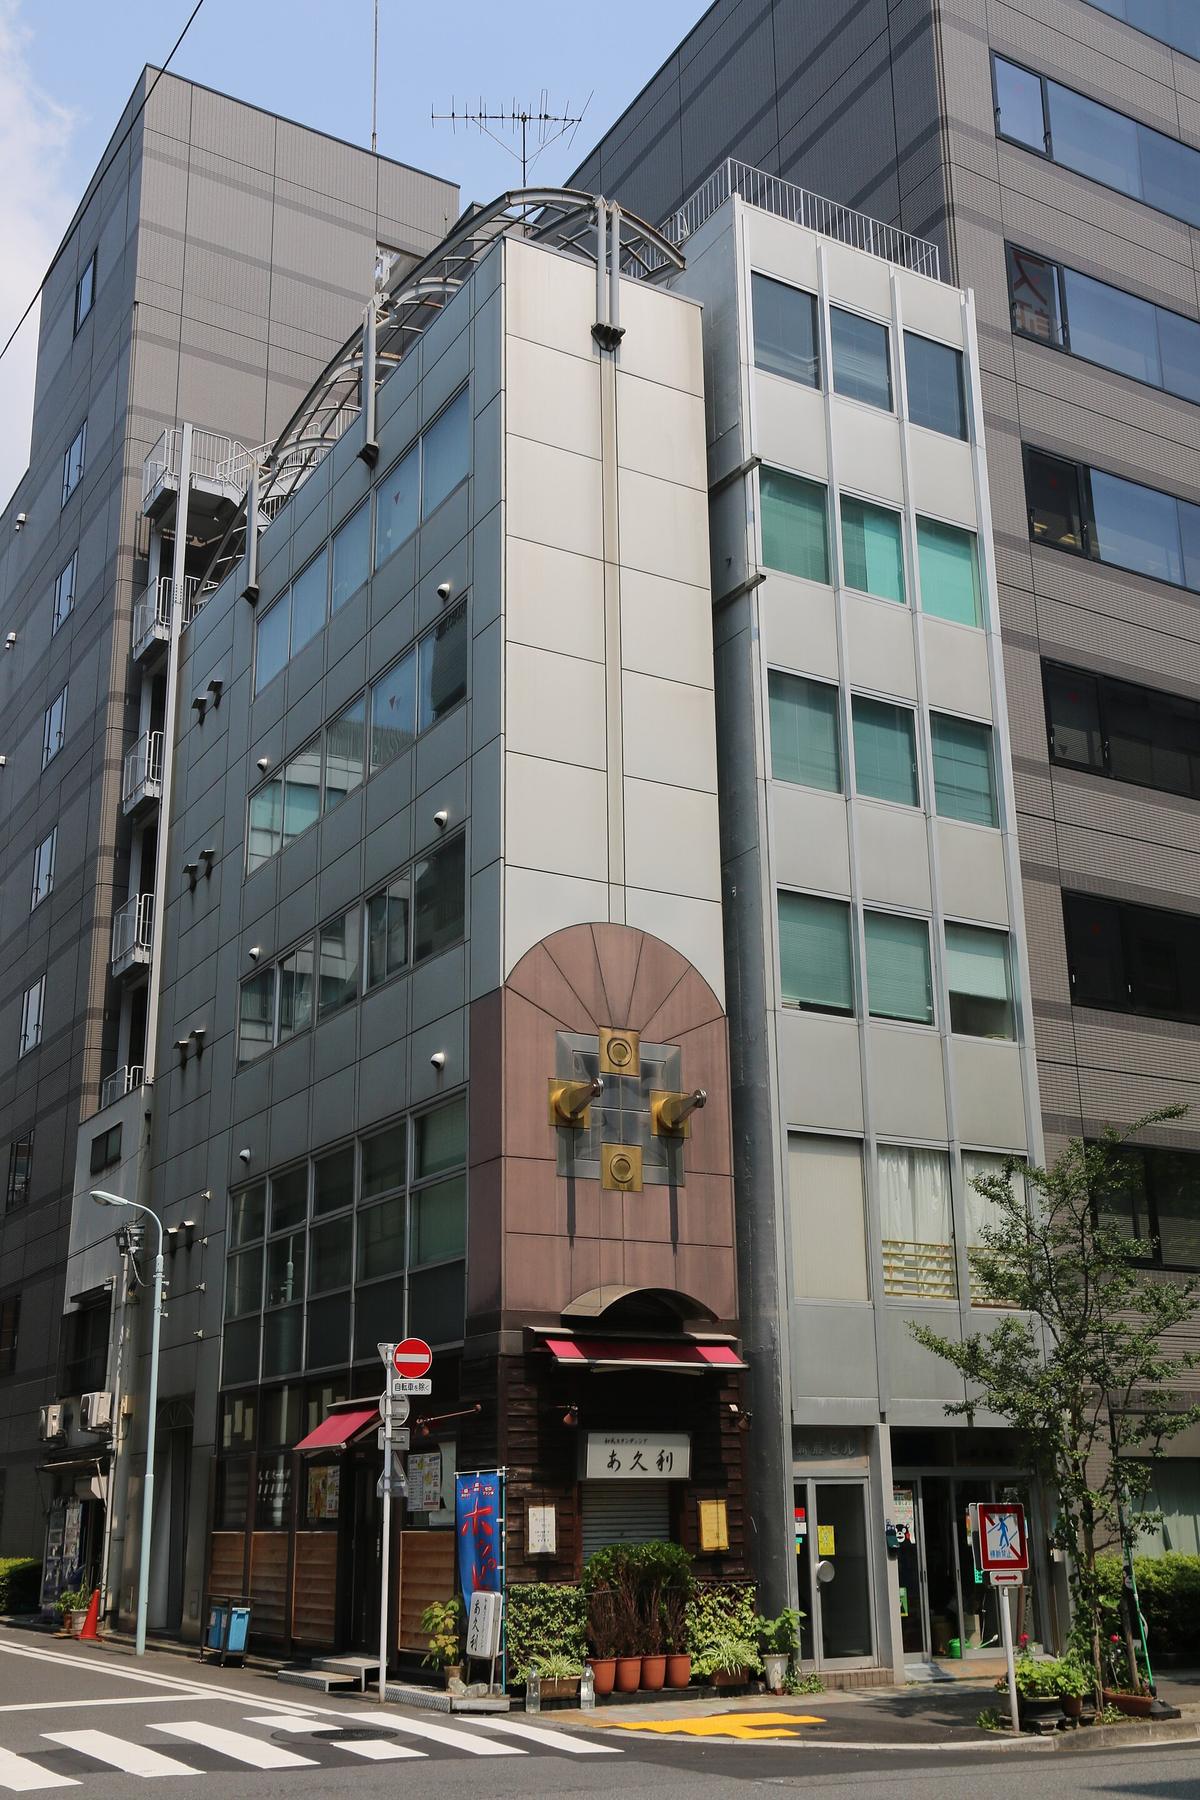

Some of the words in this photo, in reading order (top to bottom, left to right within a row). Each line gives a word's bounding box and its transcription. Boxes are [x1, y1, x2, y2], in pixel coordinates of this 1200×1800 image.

[395, 1382, 430, 1392] 自転車を除く
[606, 1449, 674, 1472] あ久利
[461, 1497, 498, 1592] ホッピ
[469, 1599, 481, 1652] あ久利
